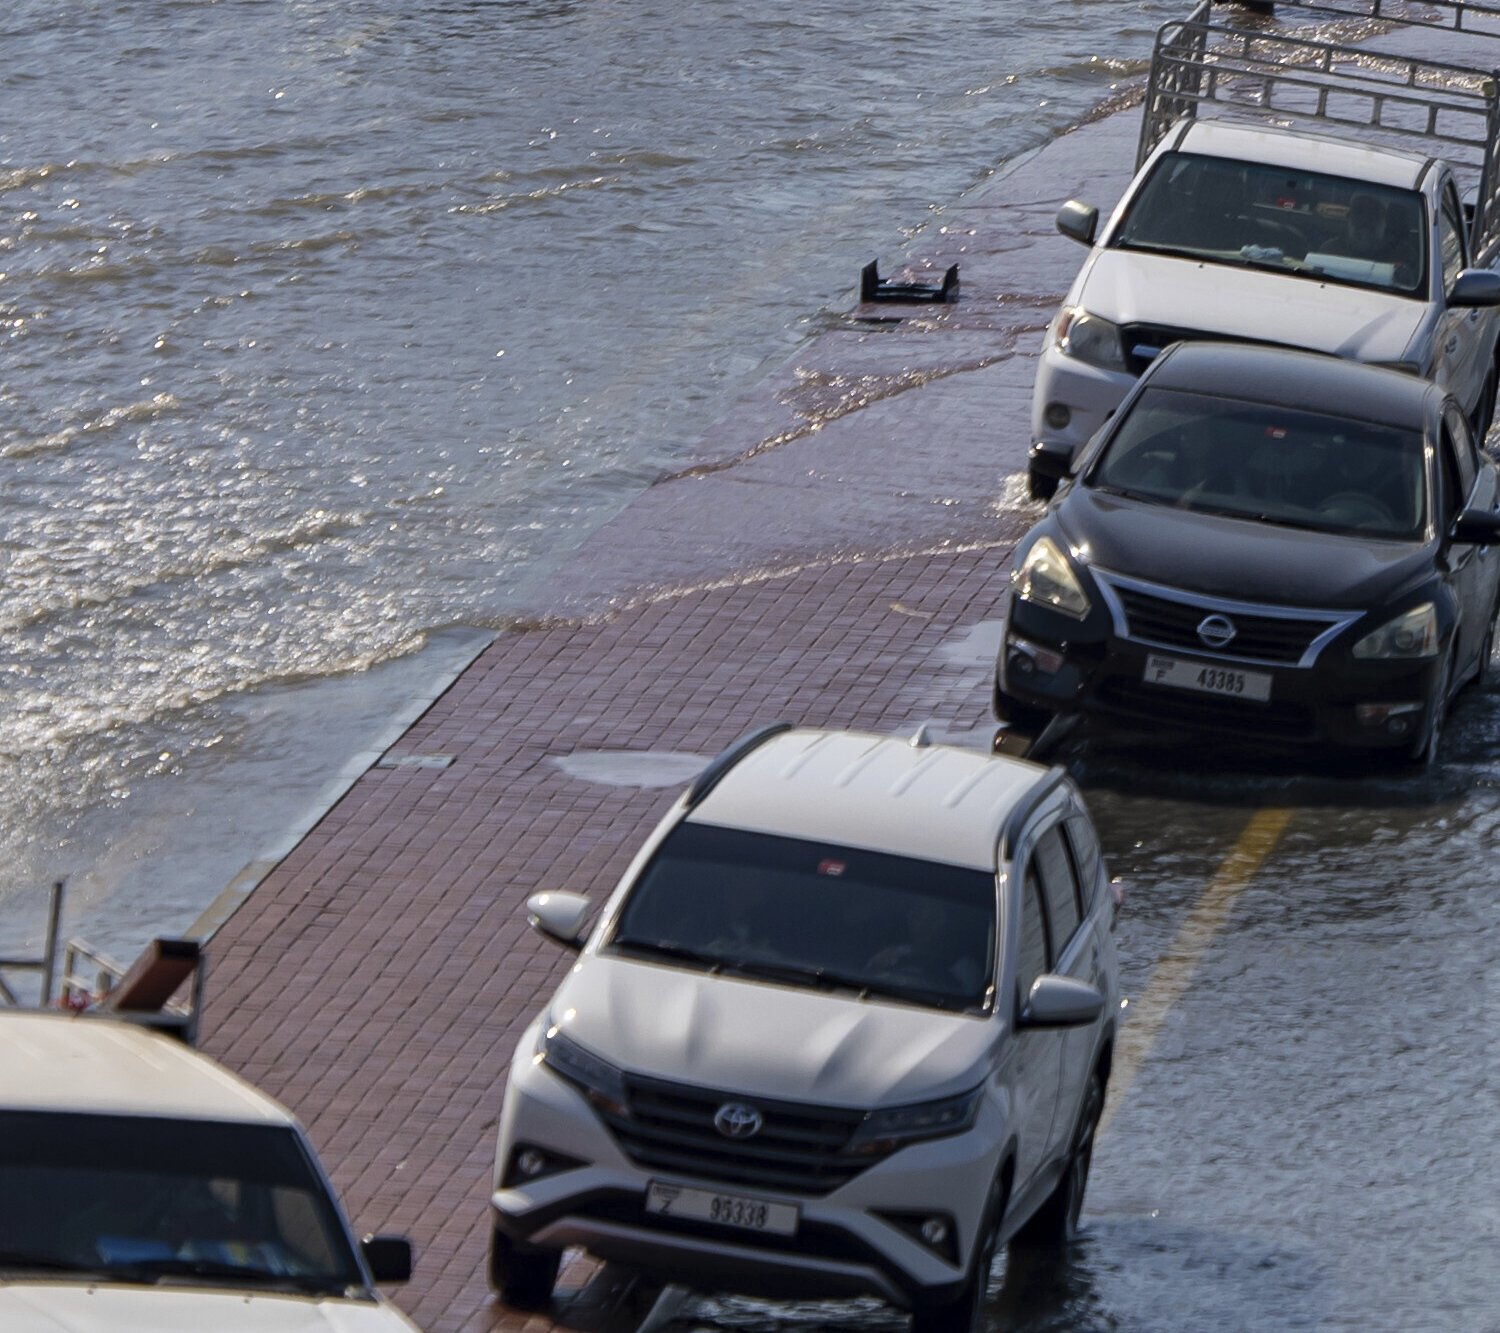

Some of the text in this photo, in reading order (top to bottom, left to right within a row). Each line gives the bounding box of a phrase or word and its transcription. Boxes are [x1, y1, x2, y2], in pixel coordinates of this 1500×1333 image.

[1157, 670, 1167, 682] F
[1196, 668, 1246, 694] 43385
[660, 1199, 672, 1213] Z
[710, 1196, 770, 1230] 95338
